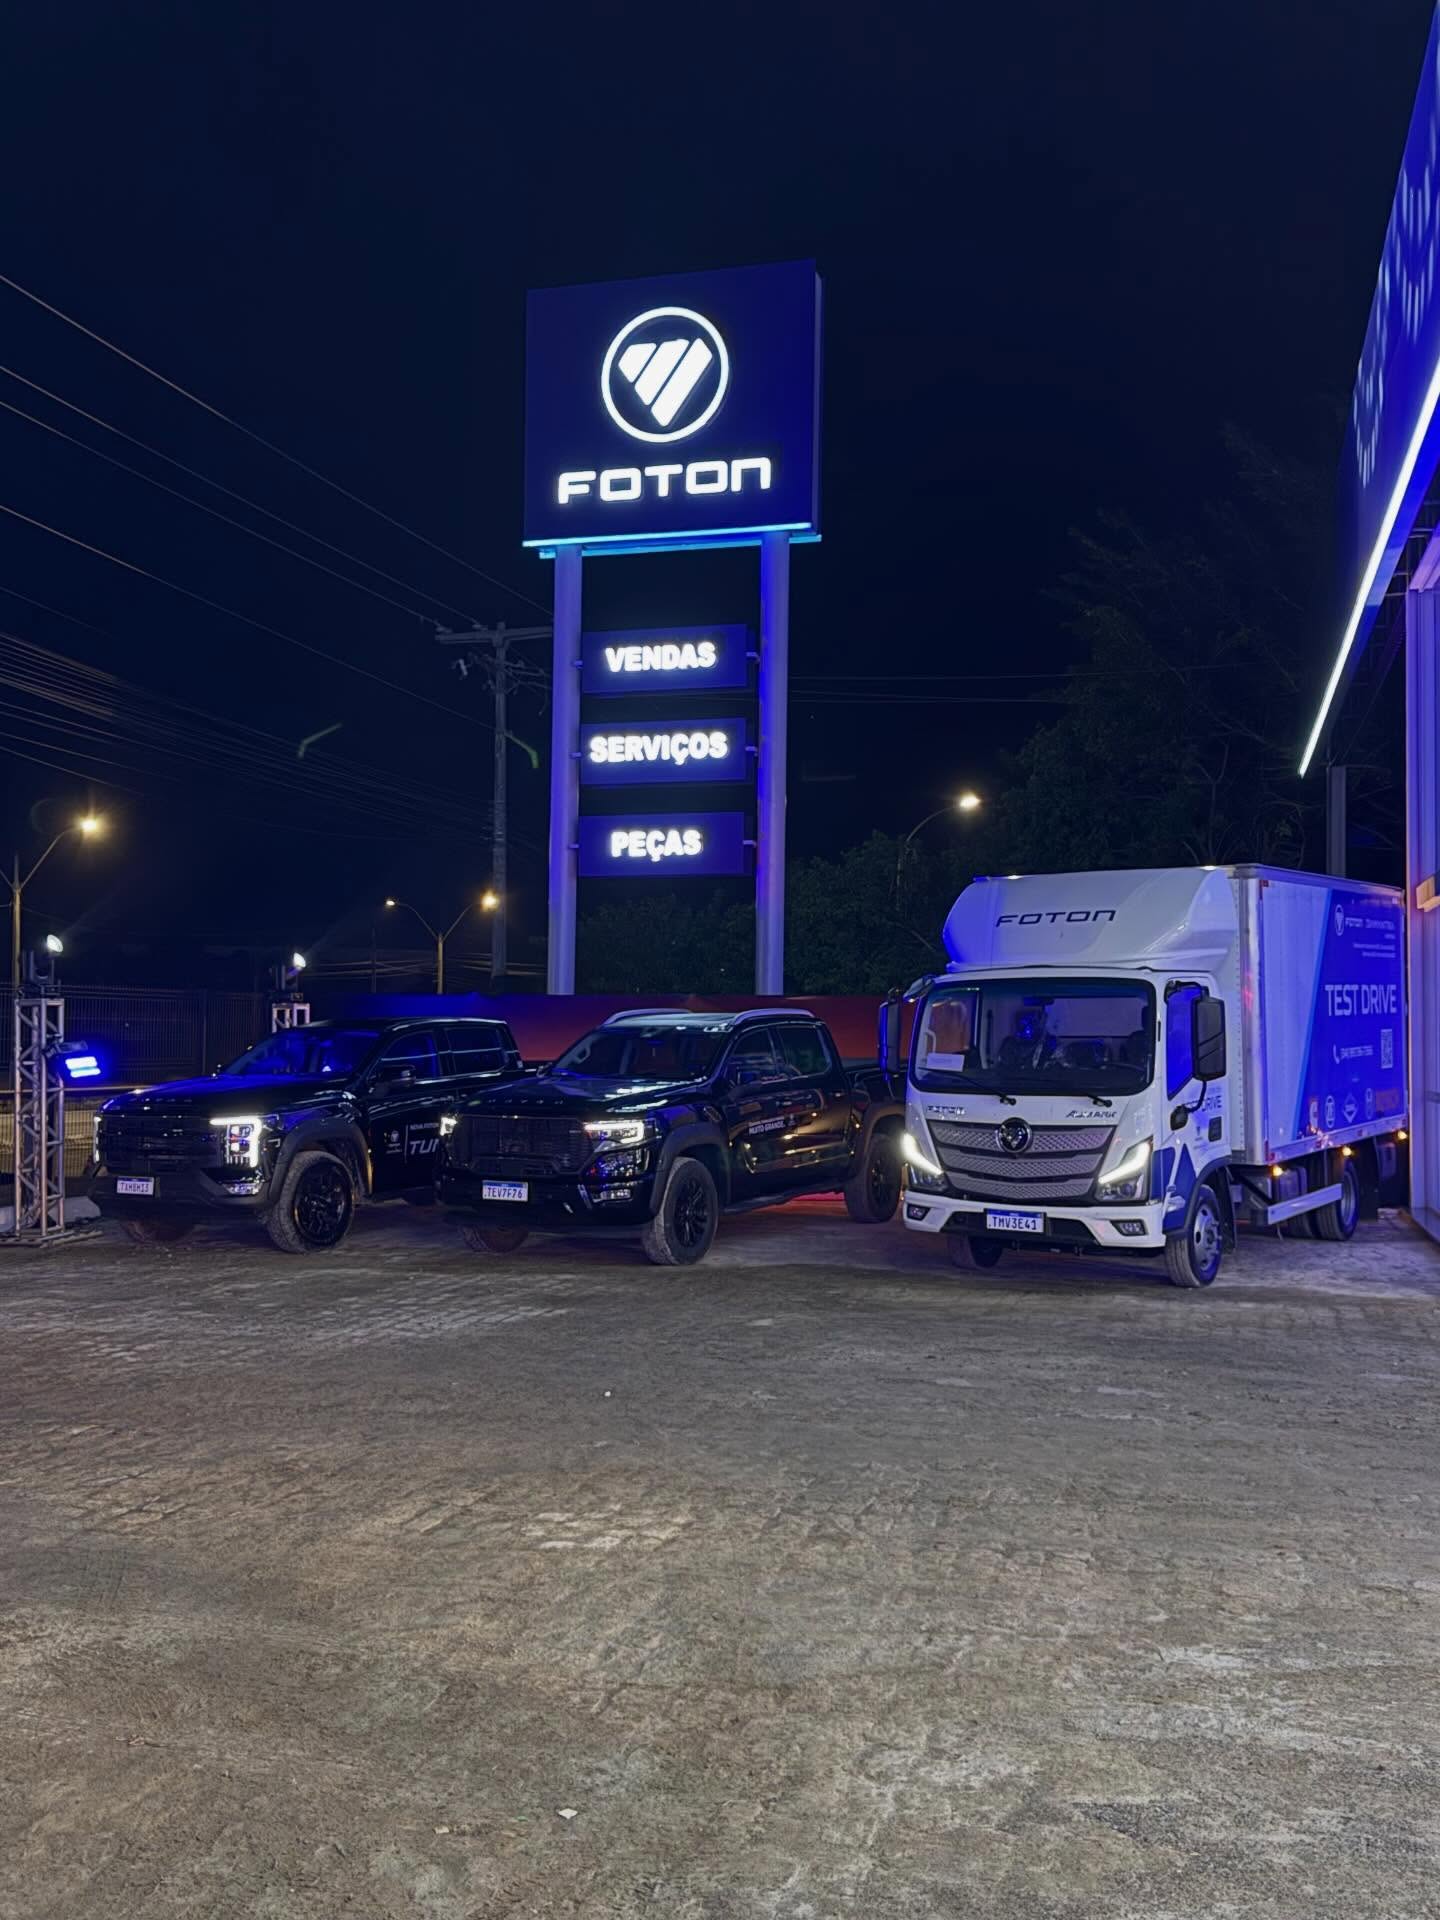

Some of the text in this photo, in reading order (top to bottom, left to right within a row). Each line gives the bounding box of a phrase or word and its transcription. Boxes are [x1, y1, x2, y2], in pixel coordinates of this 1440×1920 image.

[558, 457, 771, 504] FOTON
[605, 642, 716, 672] VENDAS
[590, 732, 728, 765] SERVIÇOS
[611, 830, 702, 862] PEÇAS
[995, 909, 1117, 928] FOTON
[1324, 984, 1397, 1016] TEST DRIVE
[992, 1216, 1037, 1231] TMV3E41
